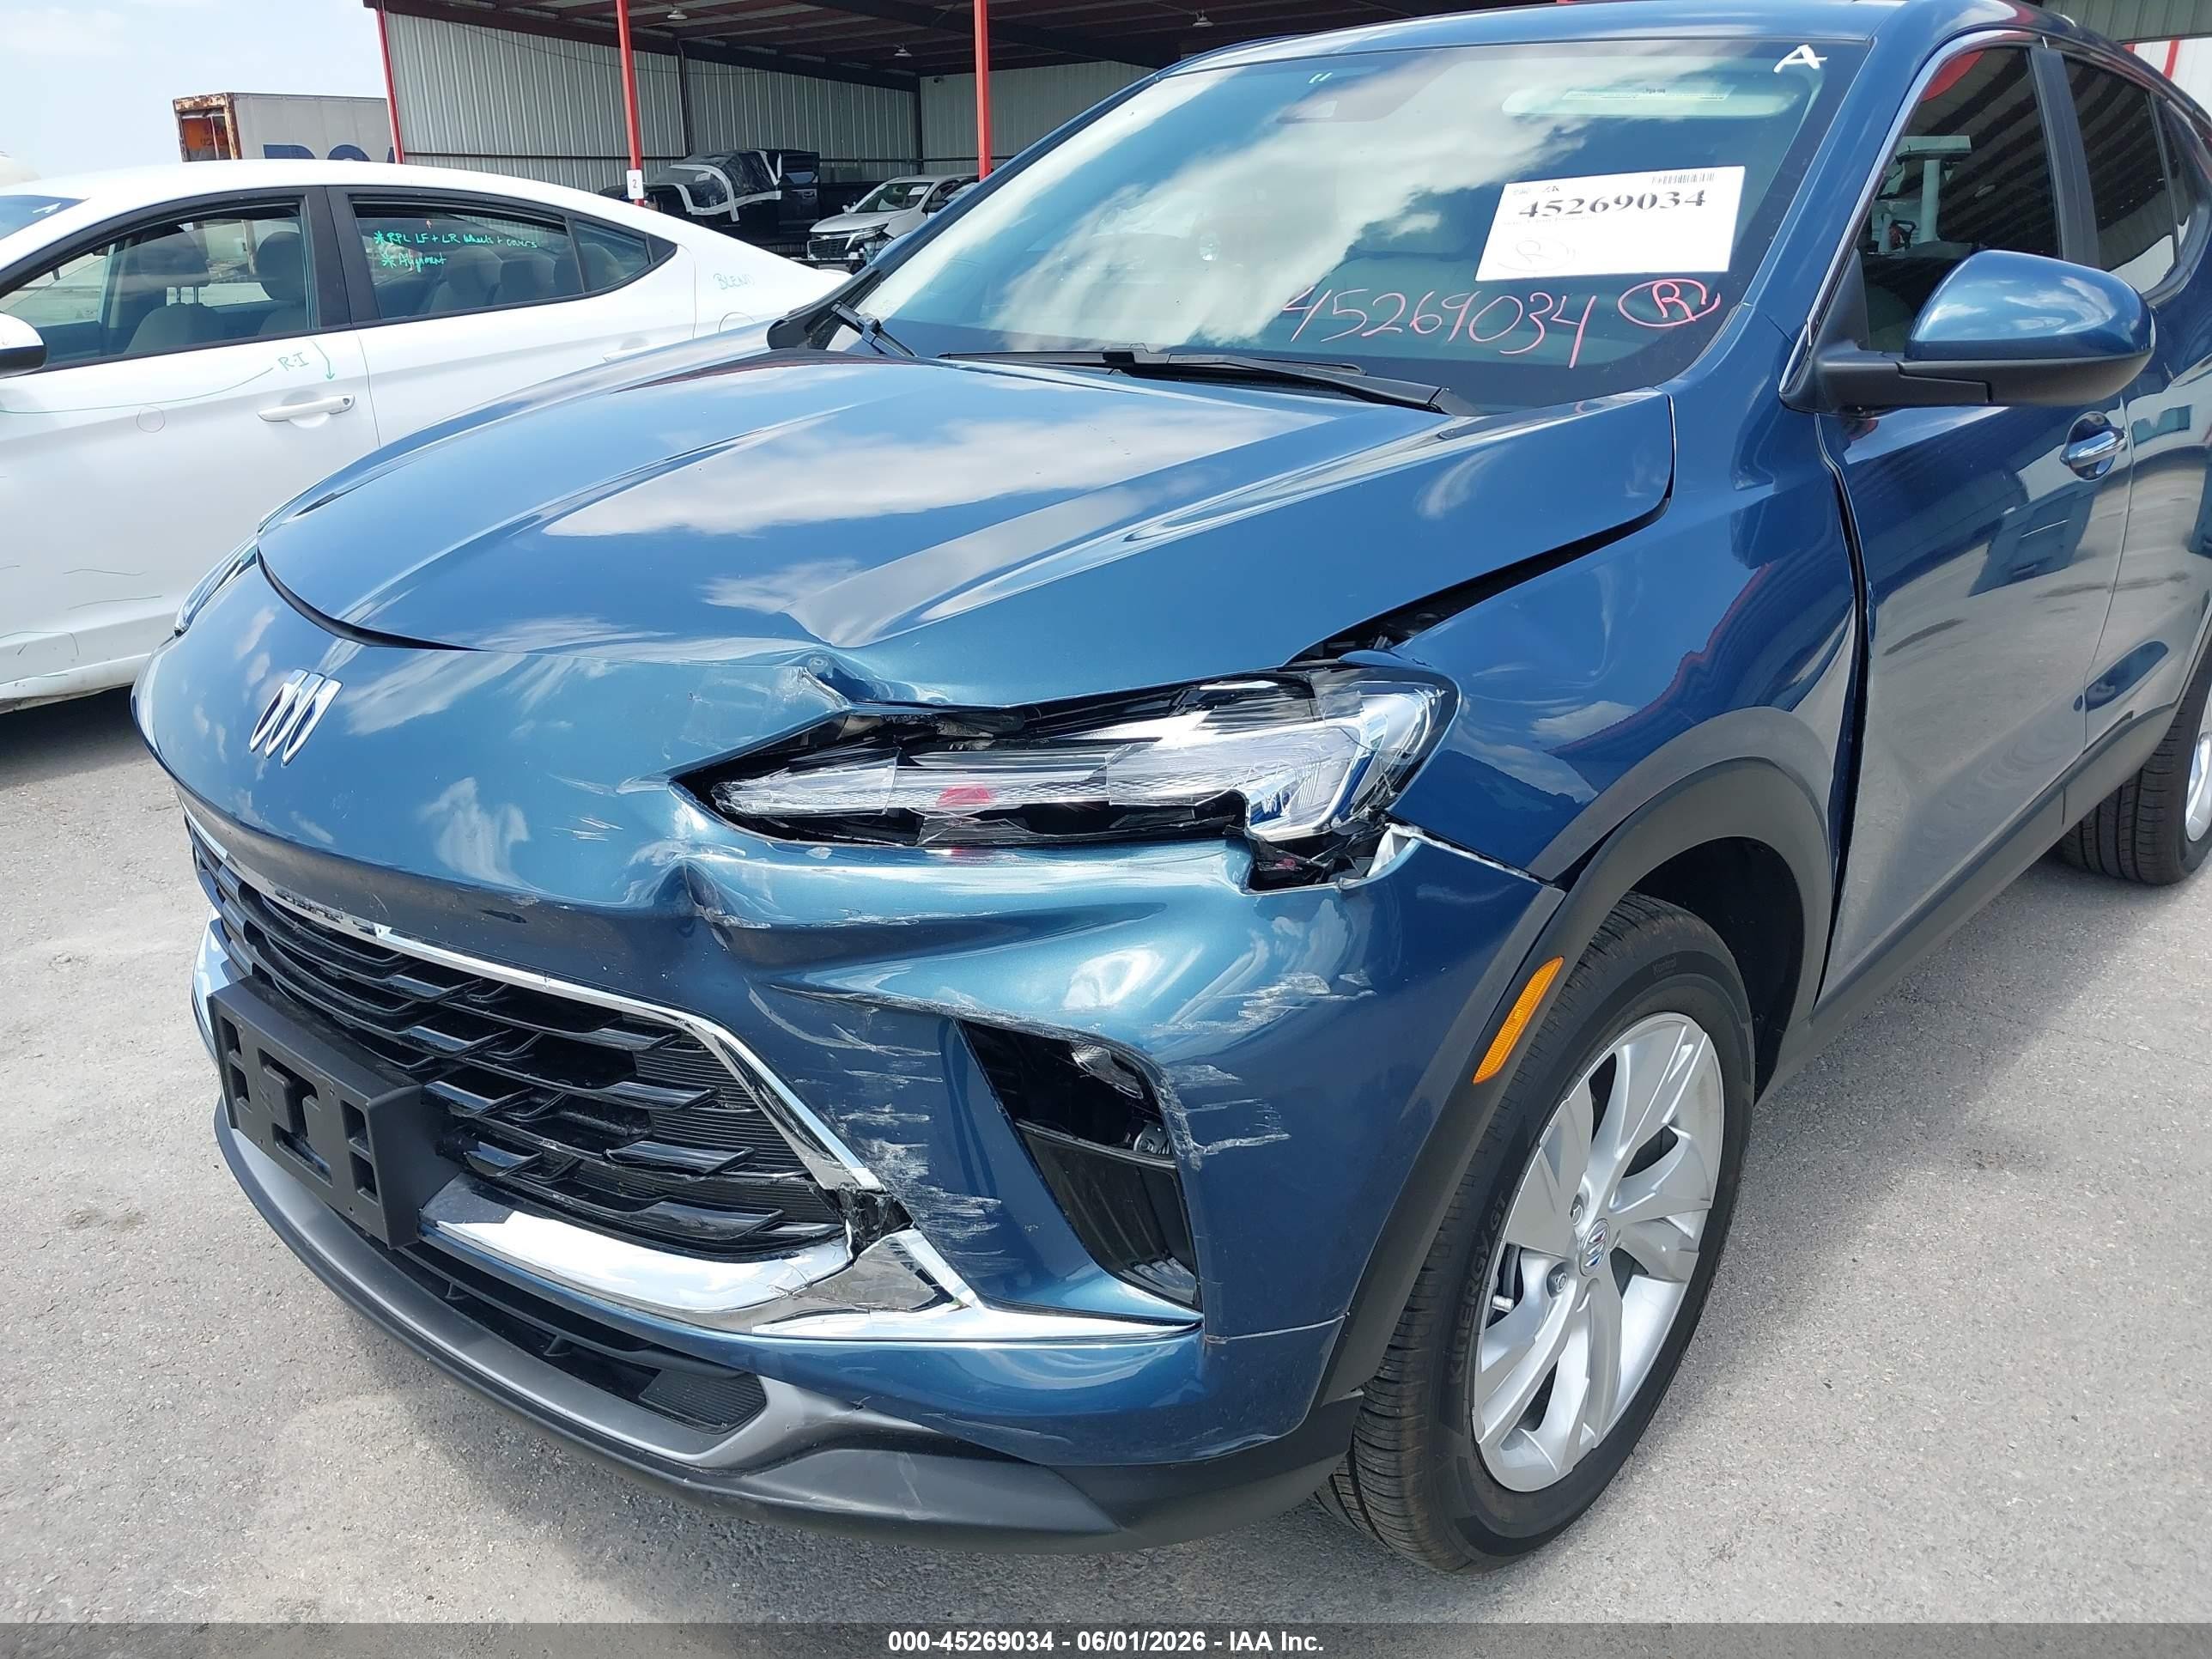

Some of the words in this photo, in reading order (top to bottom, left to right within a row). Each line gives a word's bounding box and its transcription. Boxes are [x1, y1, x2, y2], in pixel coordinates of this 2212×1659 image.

[1773, 44, 1828, 73] A
[632, 179, 639, 189] 2
[1518, 190, 1706, 218] 45269034
[386, 233, 411, 244] RPL
[416, 234, 429, 243] LF
[442, 234, 461, 243] LR
[1282, 286, 1597, 369] 45269034
